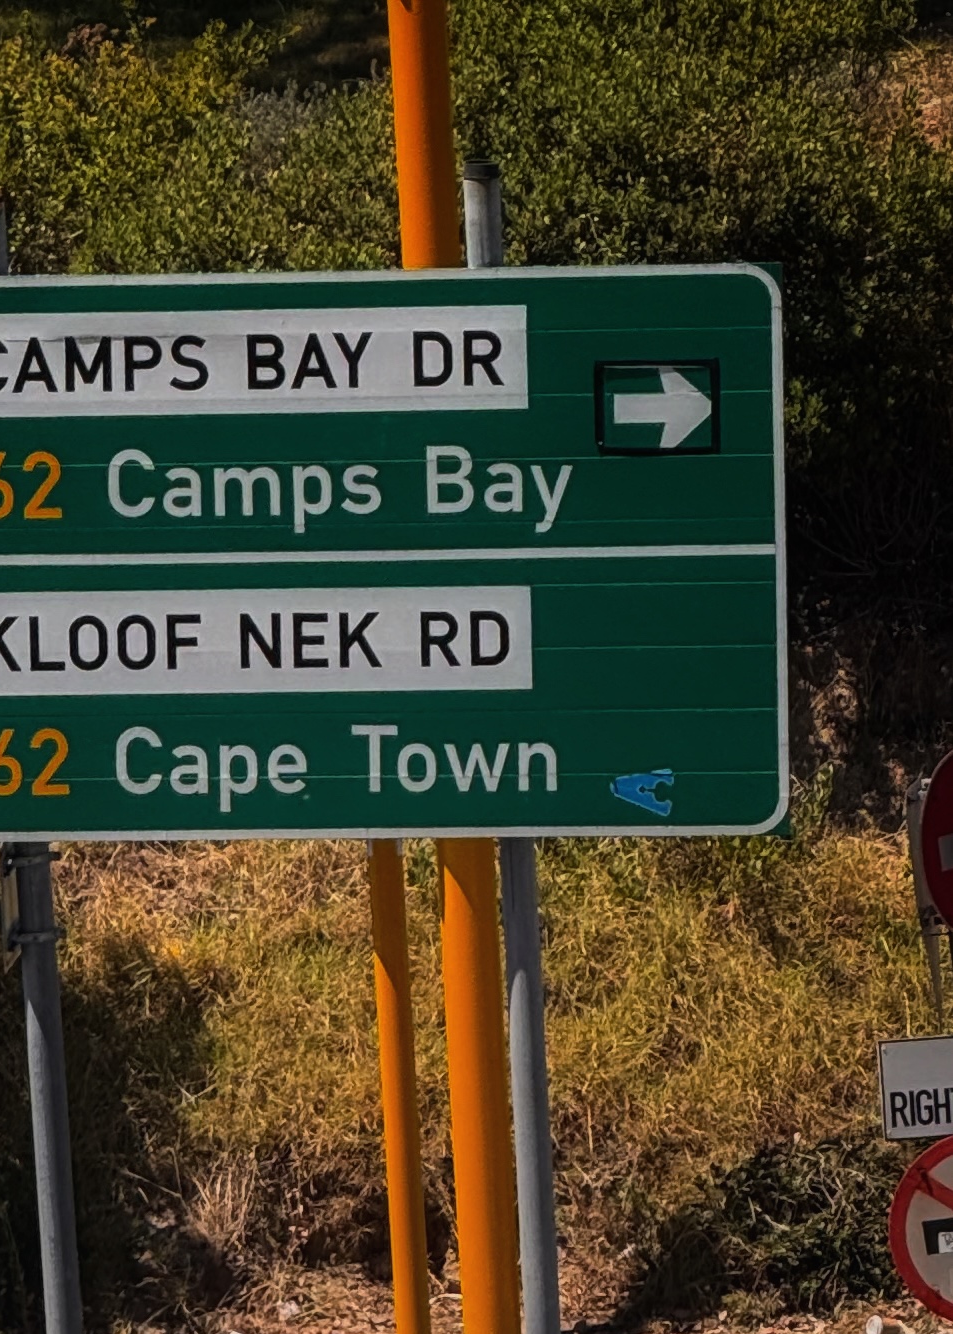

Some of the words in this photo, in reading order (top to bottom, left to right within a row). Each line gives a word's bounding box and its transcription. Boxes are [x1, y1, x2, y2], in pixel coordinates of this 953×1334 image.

[246, 331, 373, 390] BAY
[412, 330, 505, 387] DR
[107, 448, 382, 534] Camps
[426, 444, 573, 533] Bay
[239, 611, 383, 669] NEK
[419, 610, 511, 668] RD
[114, 726, 308, 813] Cape
[350, 724, 559, 793] Town
[889, 1087, 953, 1129] RIGH
